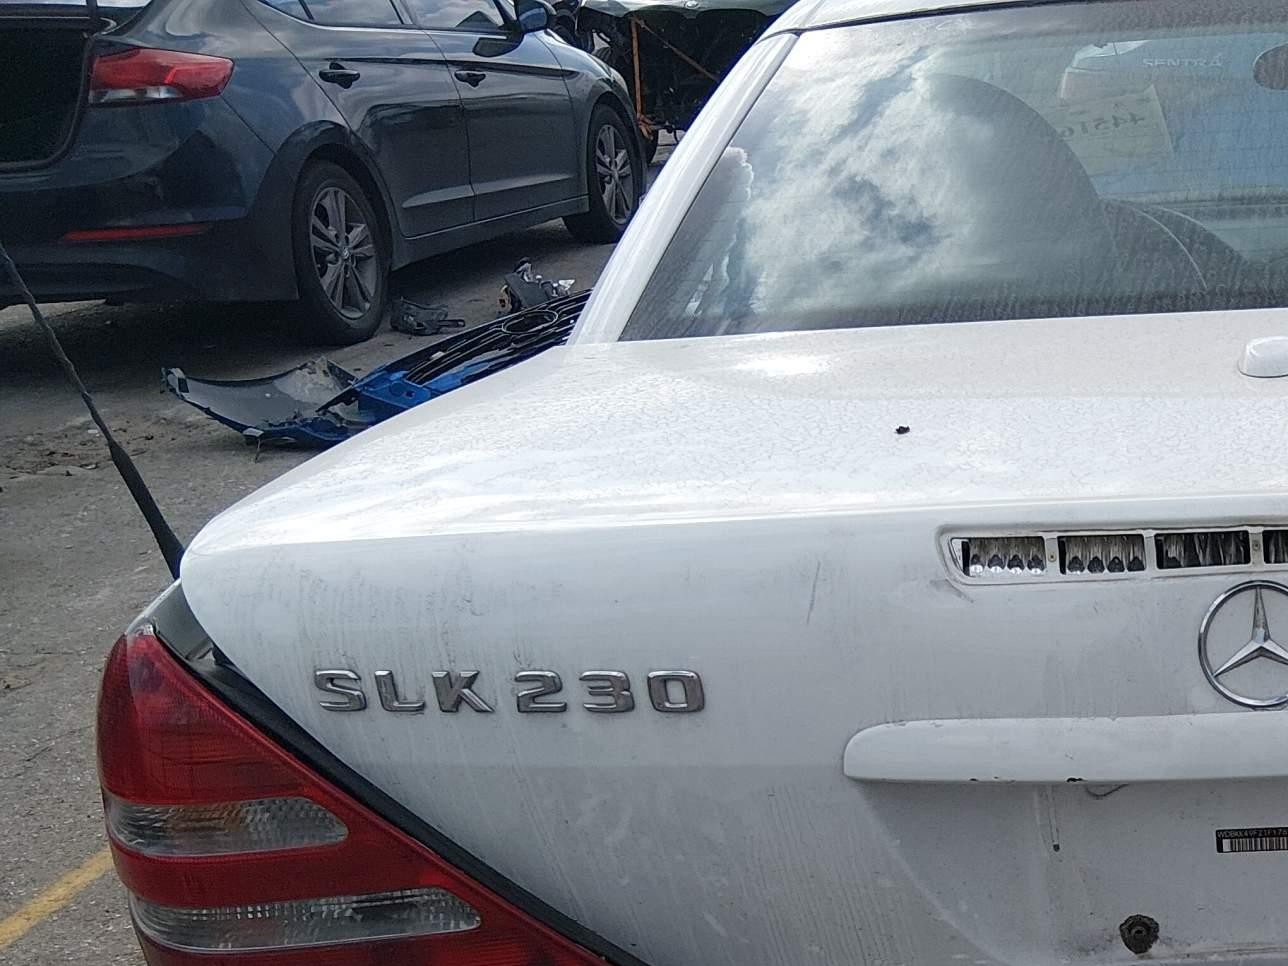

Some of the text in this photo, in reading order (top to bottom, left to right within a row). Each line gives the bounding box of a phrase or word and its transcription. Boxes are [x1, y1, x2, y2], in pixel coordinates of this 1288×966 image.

[1142, 54, 1224, 67] SENTRA
[314, 669, 705, 713] SLK 230
